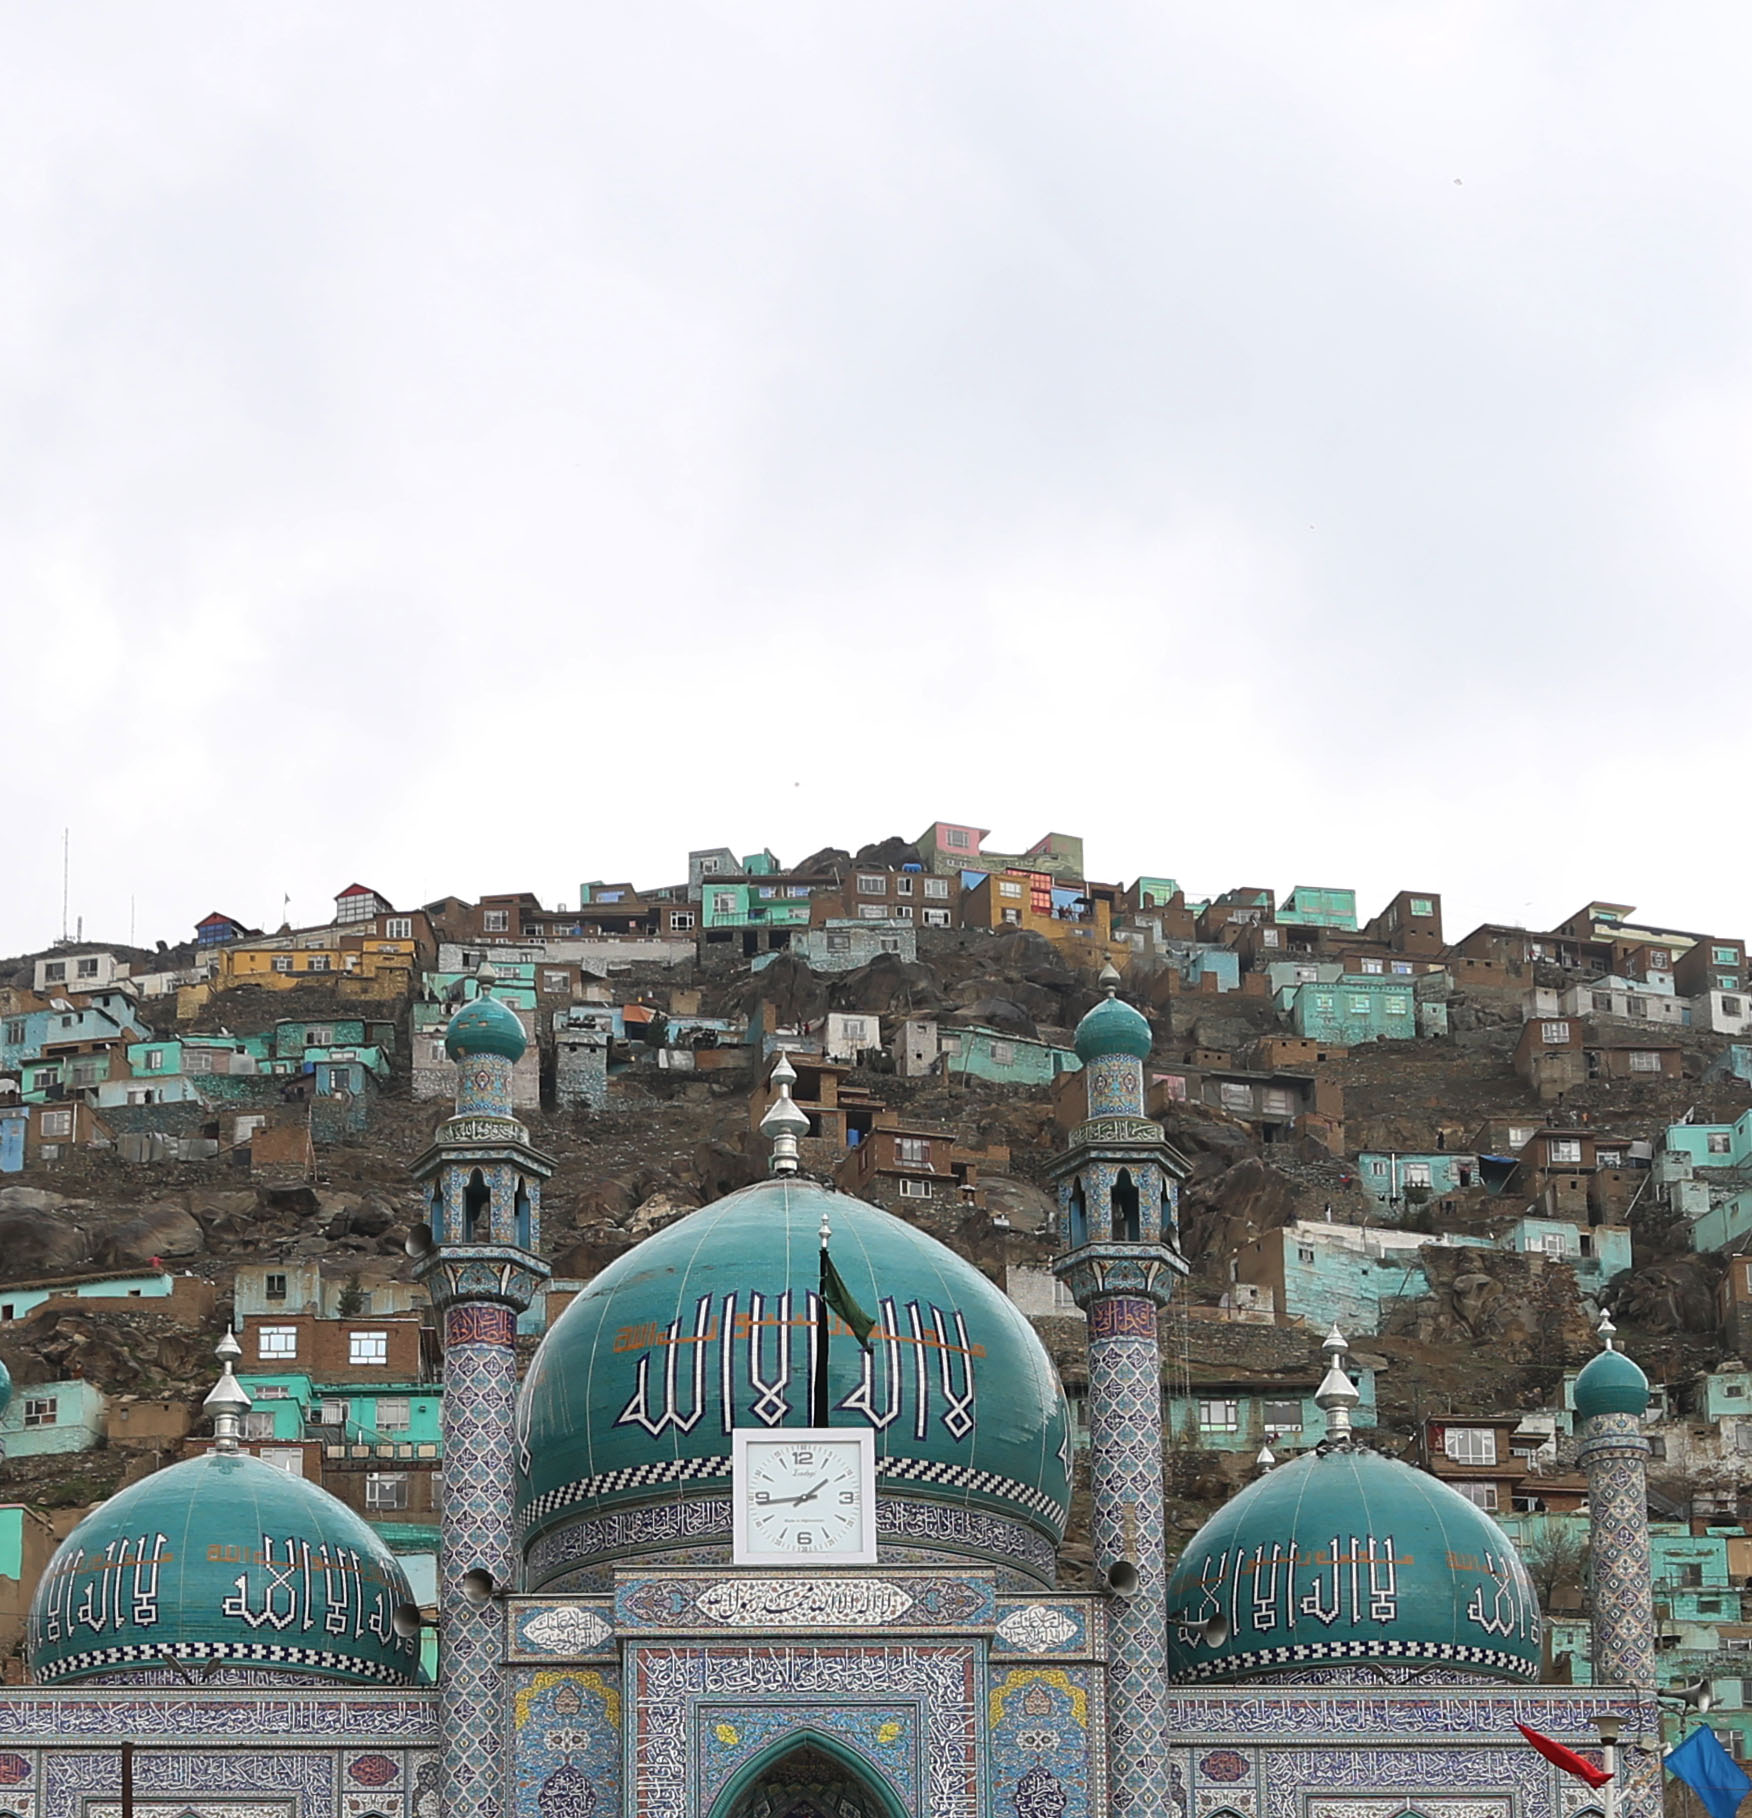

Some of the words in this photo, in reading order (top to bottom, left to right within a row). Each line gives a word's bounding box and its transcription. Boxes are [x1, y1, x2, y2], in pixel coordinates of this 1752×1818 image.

[611, 1290, 738, 1440] الله
[929, 1301, 976, 1442] لا
[792, 1451, 813, 1465] 12
[755, 1491, 770, 1505] 9
[839, 1491, 854, 1505] 3
[797, 1531, 812, 1545] 6
[222, 1533, 315, 1634] الله
